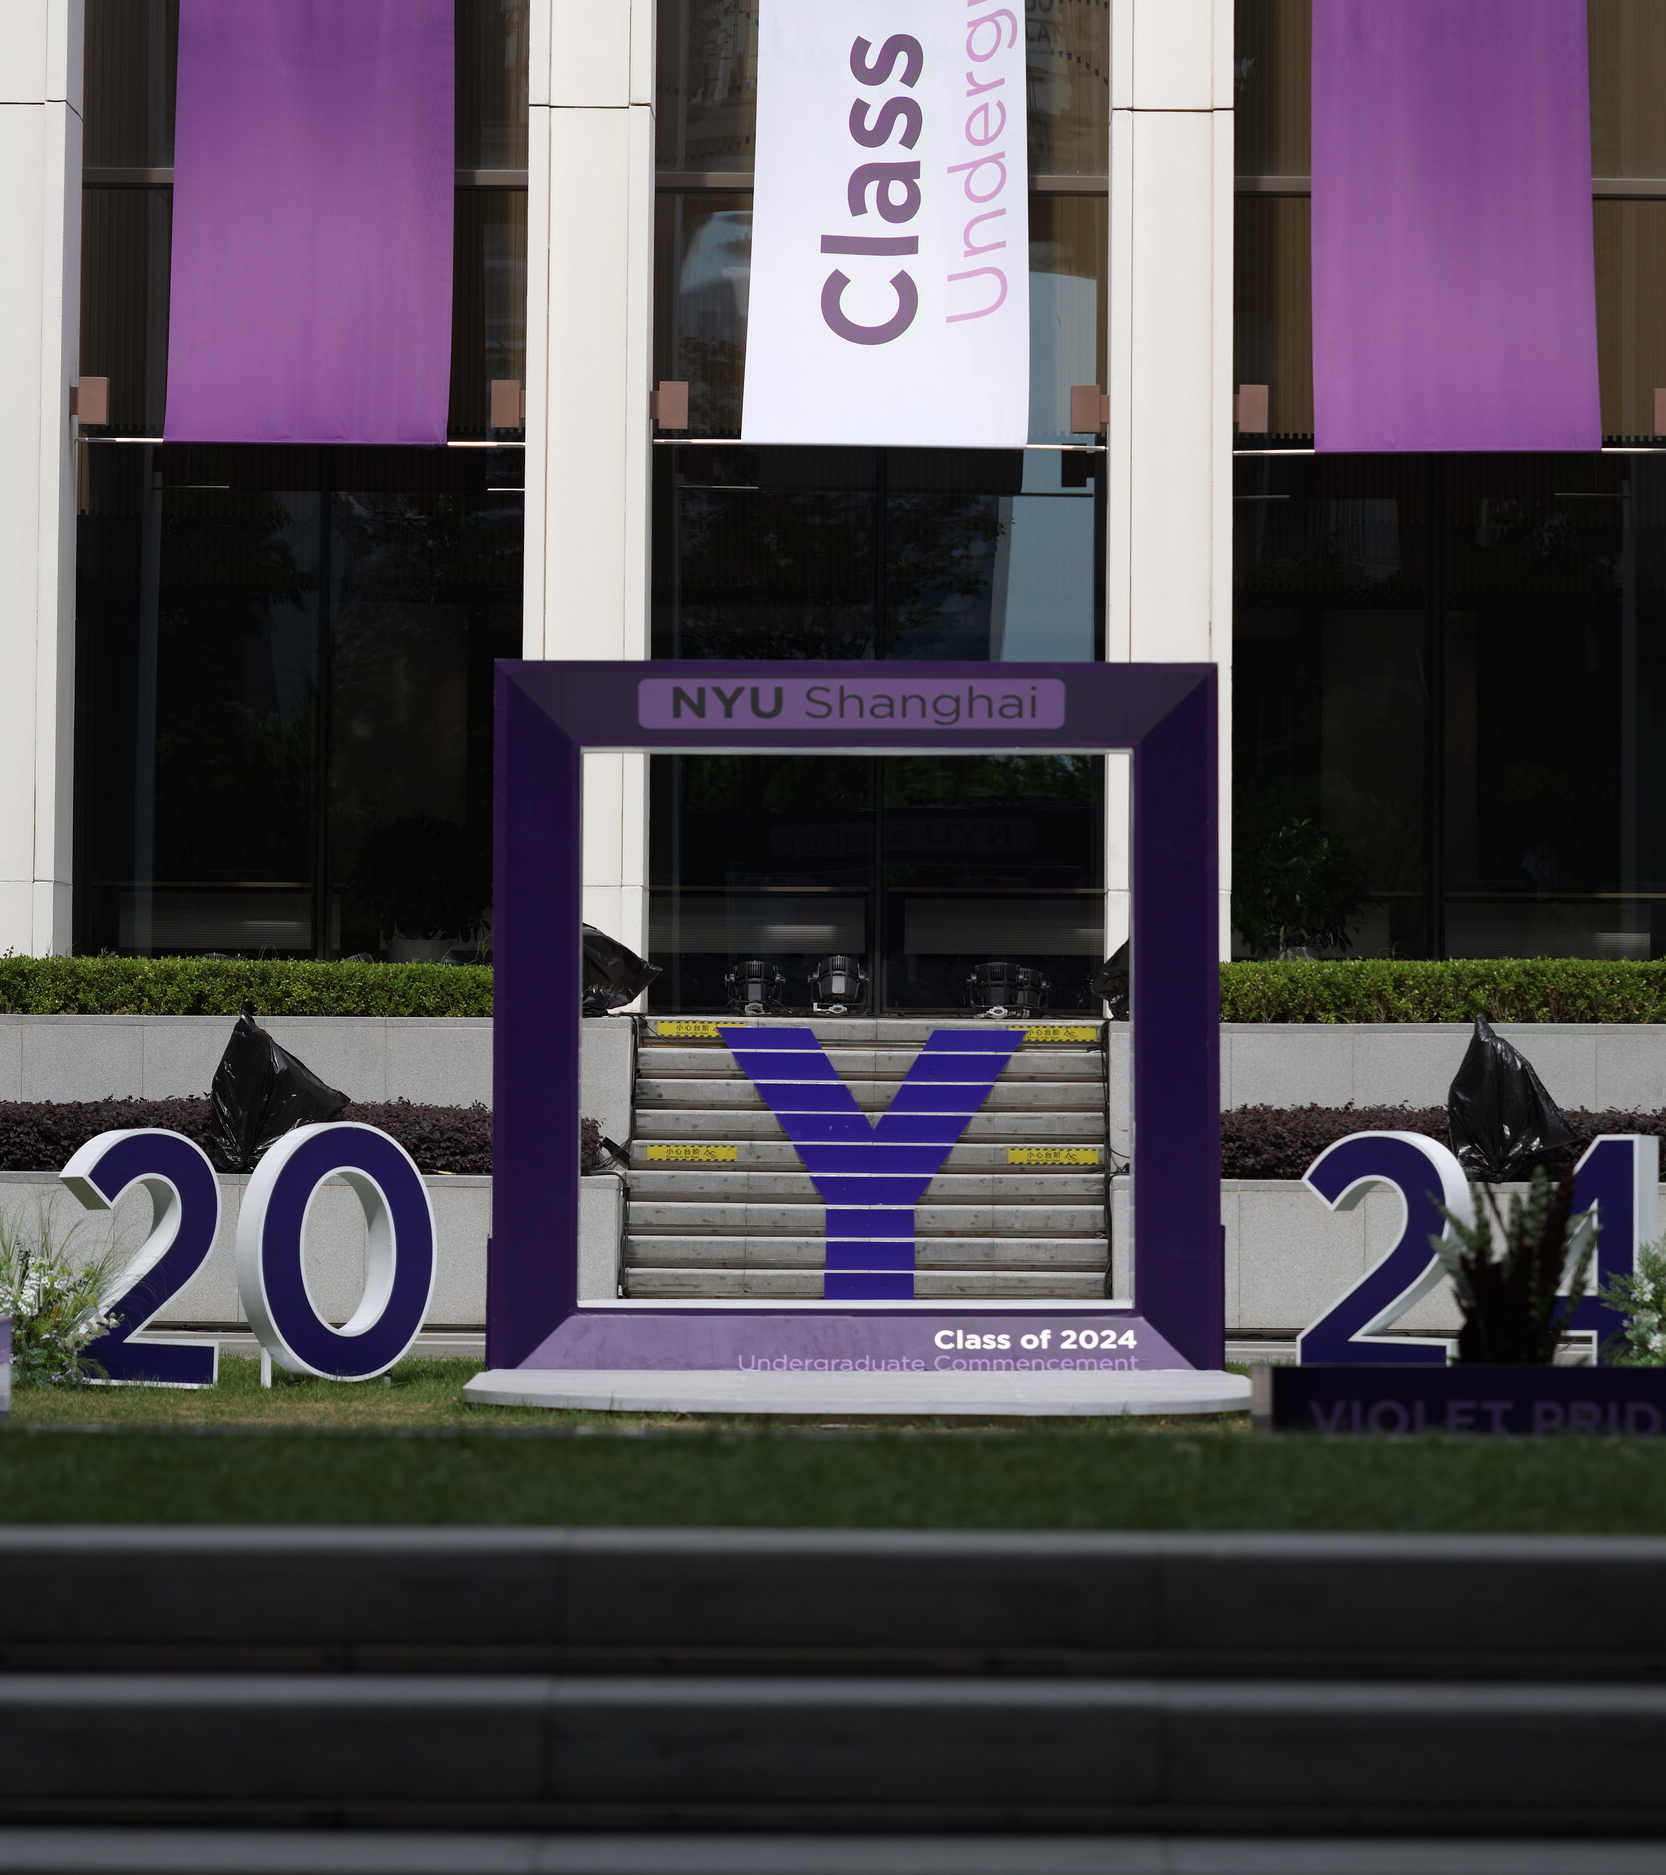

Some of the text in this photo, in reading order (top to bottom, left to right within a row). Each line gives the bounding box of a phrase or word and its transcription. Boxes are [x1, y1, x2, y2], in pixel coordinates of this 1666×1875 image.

[819, 32, 925, 346] Class
[672, 685, 1037, 726] NYU Shanghai
[676, 1024, 709, 1032] 小心台阶
[715, 1027, 1029, 1300] Y
[1027, 1151, 1061, 1159] 小心台阶
[59, 1121, 437, 1390] 20
[934, 1328, 1138, 1351] Class of 2024
[737, 1353, 1139, 1373] Undergraduate Commencement
